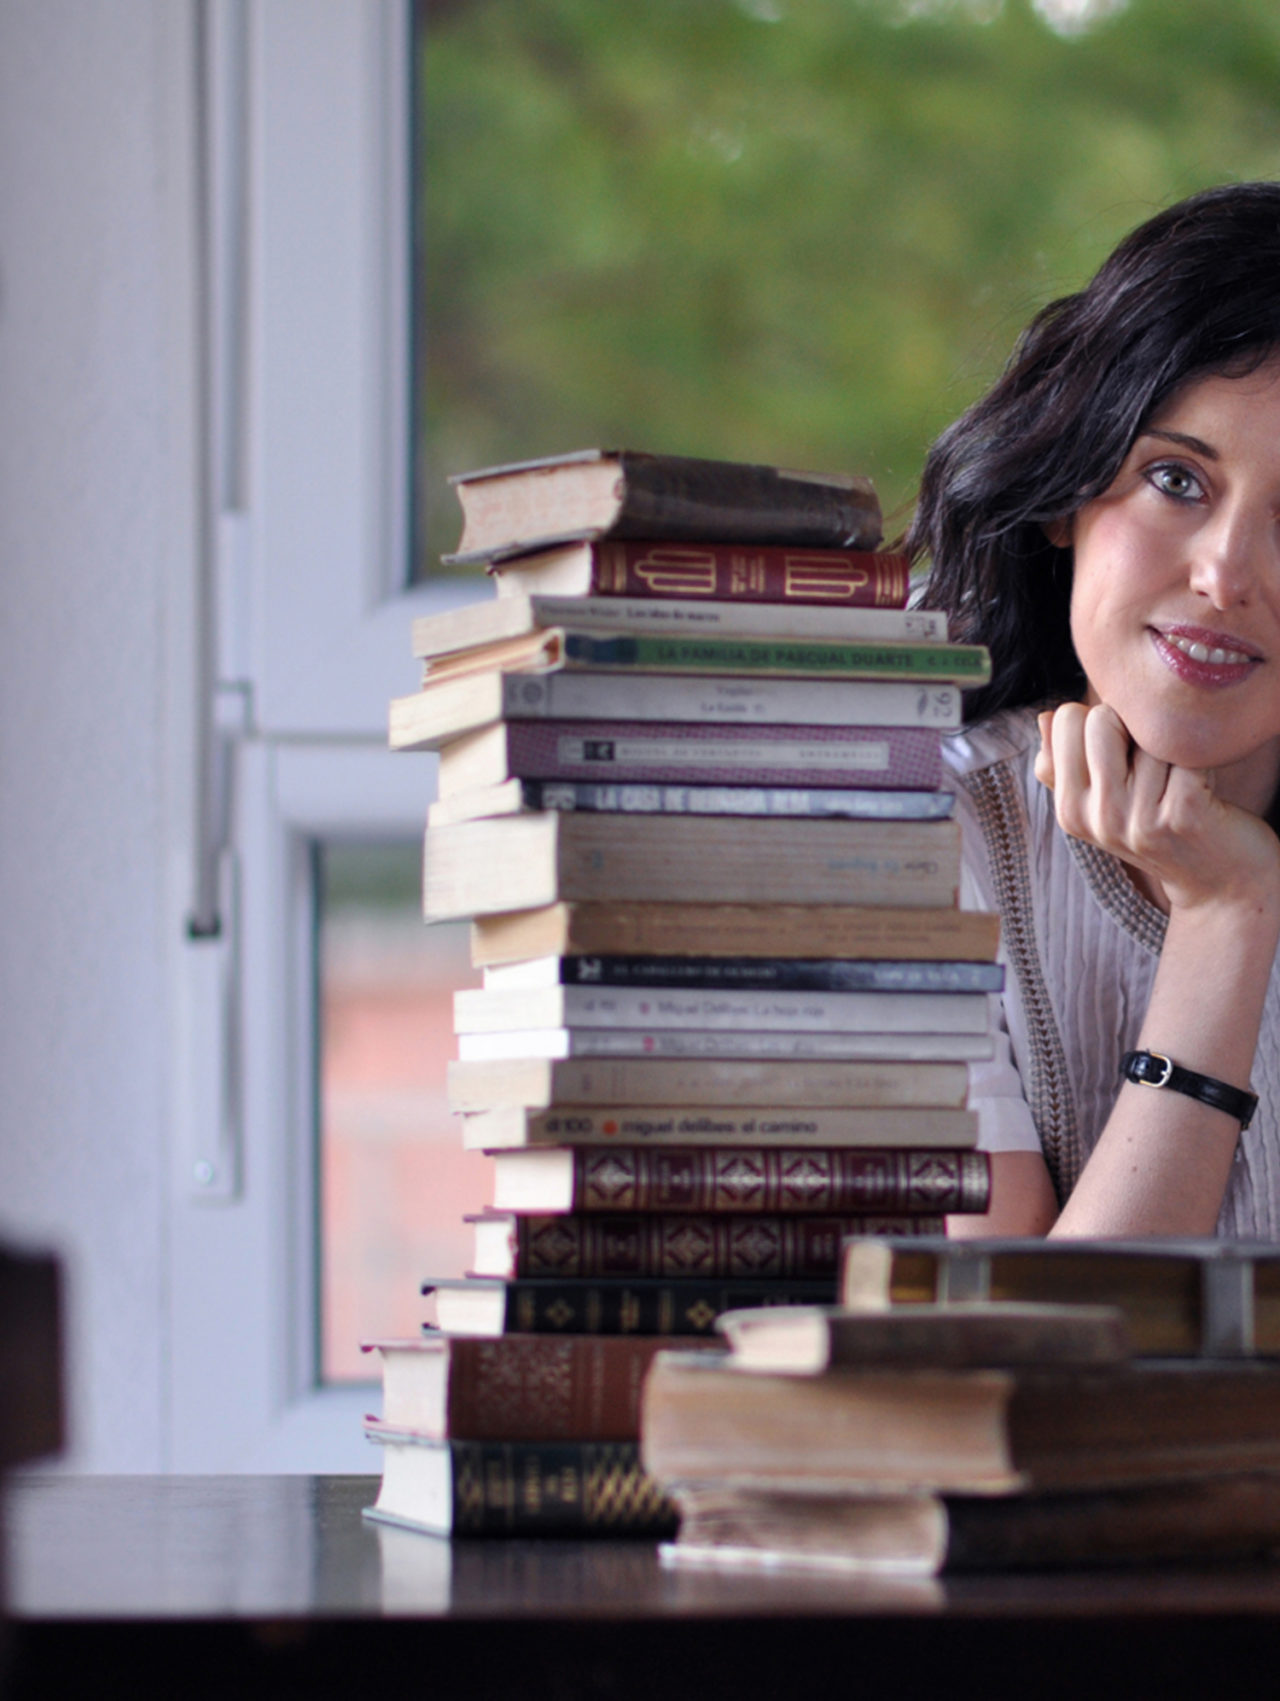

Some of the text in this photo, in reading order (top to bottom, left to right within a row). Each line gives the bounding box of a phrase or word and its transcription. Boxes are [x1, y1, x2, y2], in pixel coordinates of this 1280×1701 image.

[657, 647, 678, 662] LA
[682, 648, 747, 665] FAMILIA
[751, 650, 771, 665] DE
[775, 650, 848, 667] PASCUAL
[851, 652, 914, 669] DUARTE
[620, 1116, 674, 1136] miguel
[740, 1117, 757, 1134] el
[758, 1120, 819, 1134] camino
